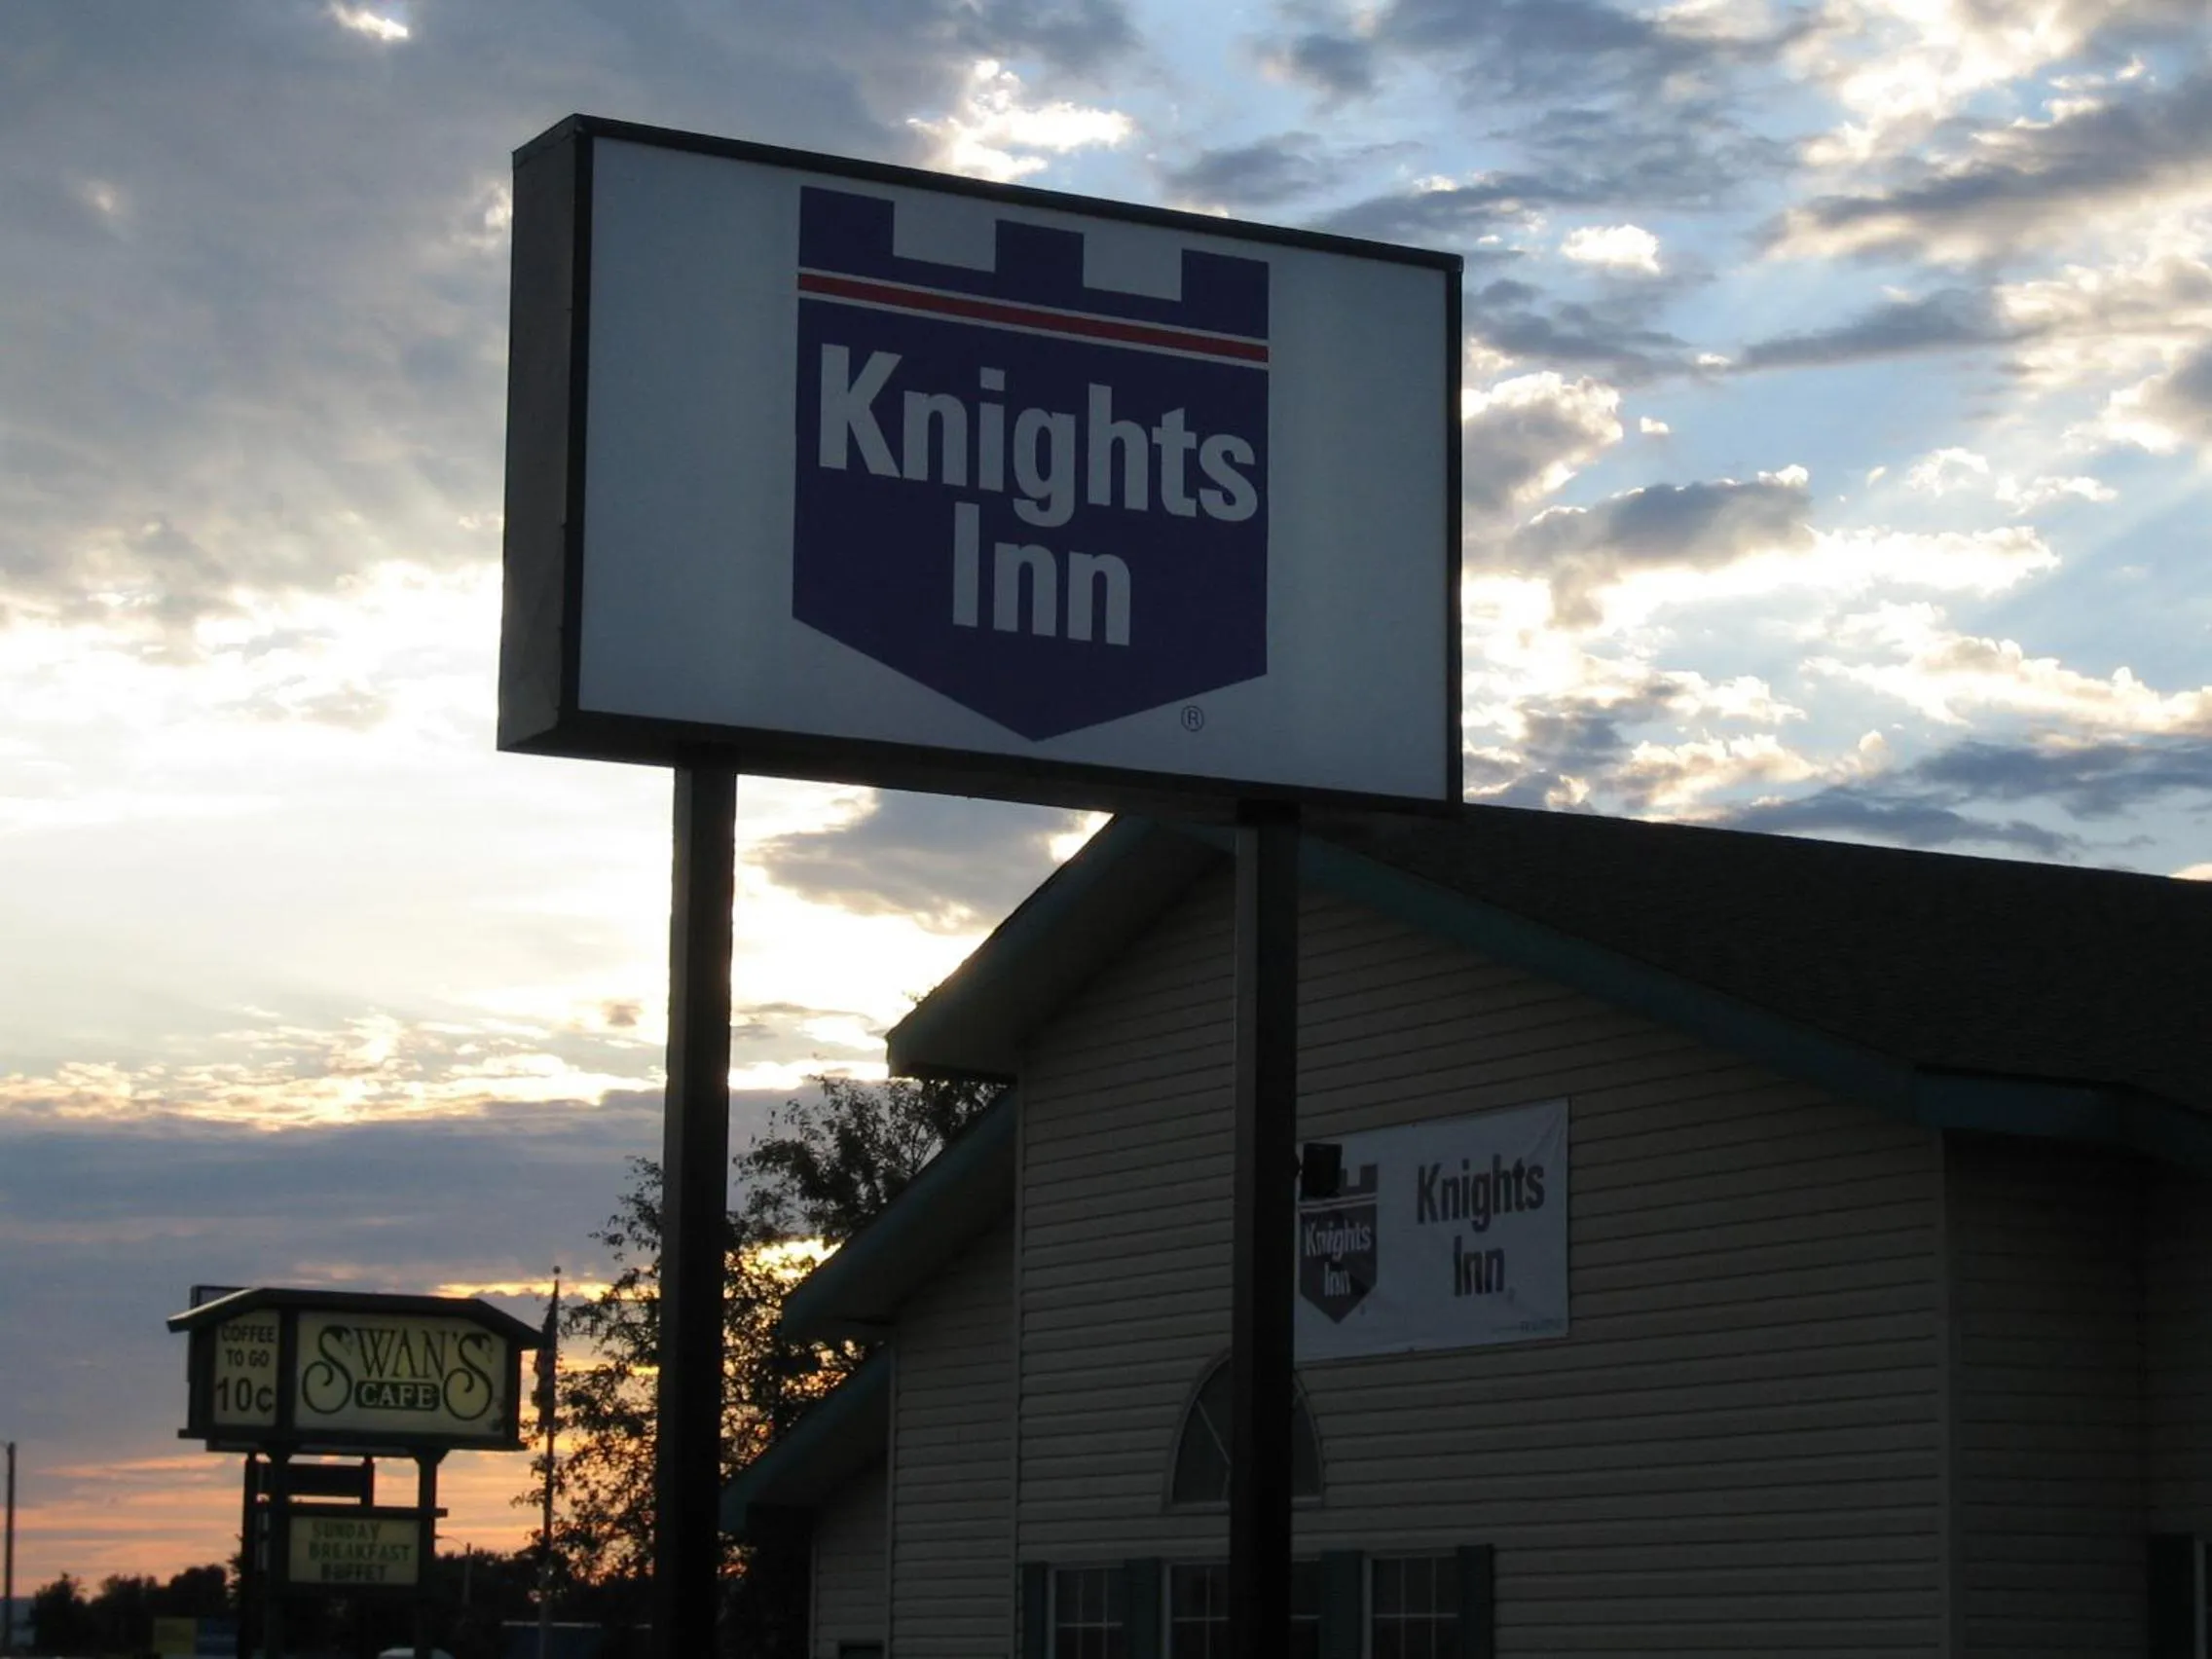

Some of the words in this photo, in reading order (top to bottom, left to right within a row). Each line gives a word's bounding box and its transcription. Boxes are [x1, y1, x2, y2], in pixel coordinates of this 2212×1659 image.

[819, 343, 1259, 528] Knights
[952, 500, 1131, 646] Inn
[1416, 1153, 1545, 1233] Knights
[1305, 1221, 1372, 1262] Knights
[1324, 1262, 1351, 1297] Inn
[1453, 1235, 1505, 1298] Inn
[220, 1323, 276, 1343] COFFEE
[226, 1349, 243, 1367] TO
[248, 1351, 270, 1369] GO
[302, 1324, 494, 1421] SWAN'S
[357, 1383, 435, 1409] CAFE
[312, 1520, 382, 1541] SUNDAY
[309, 1541, 413, 1562] BREAKFAST
[320, 1562, 388, 1581] BUFFET
